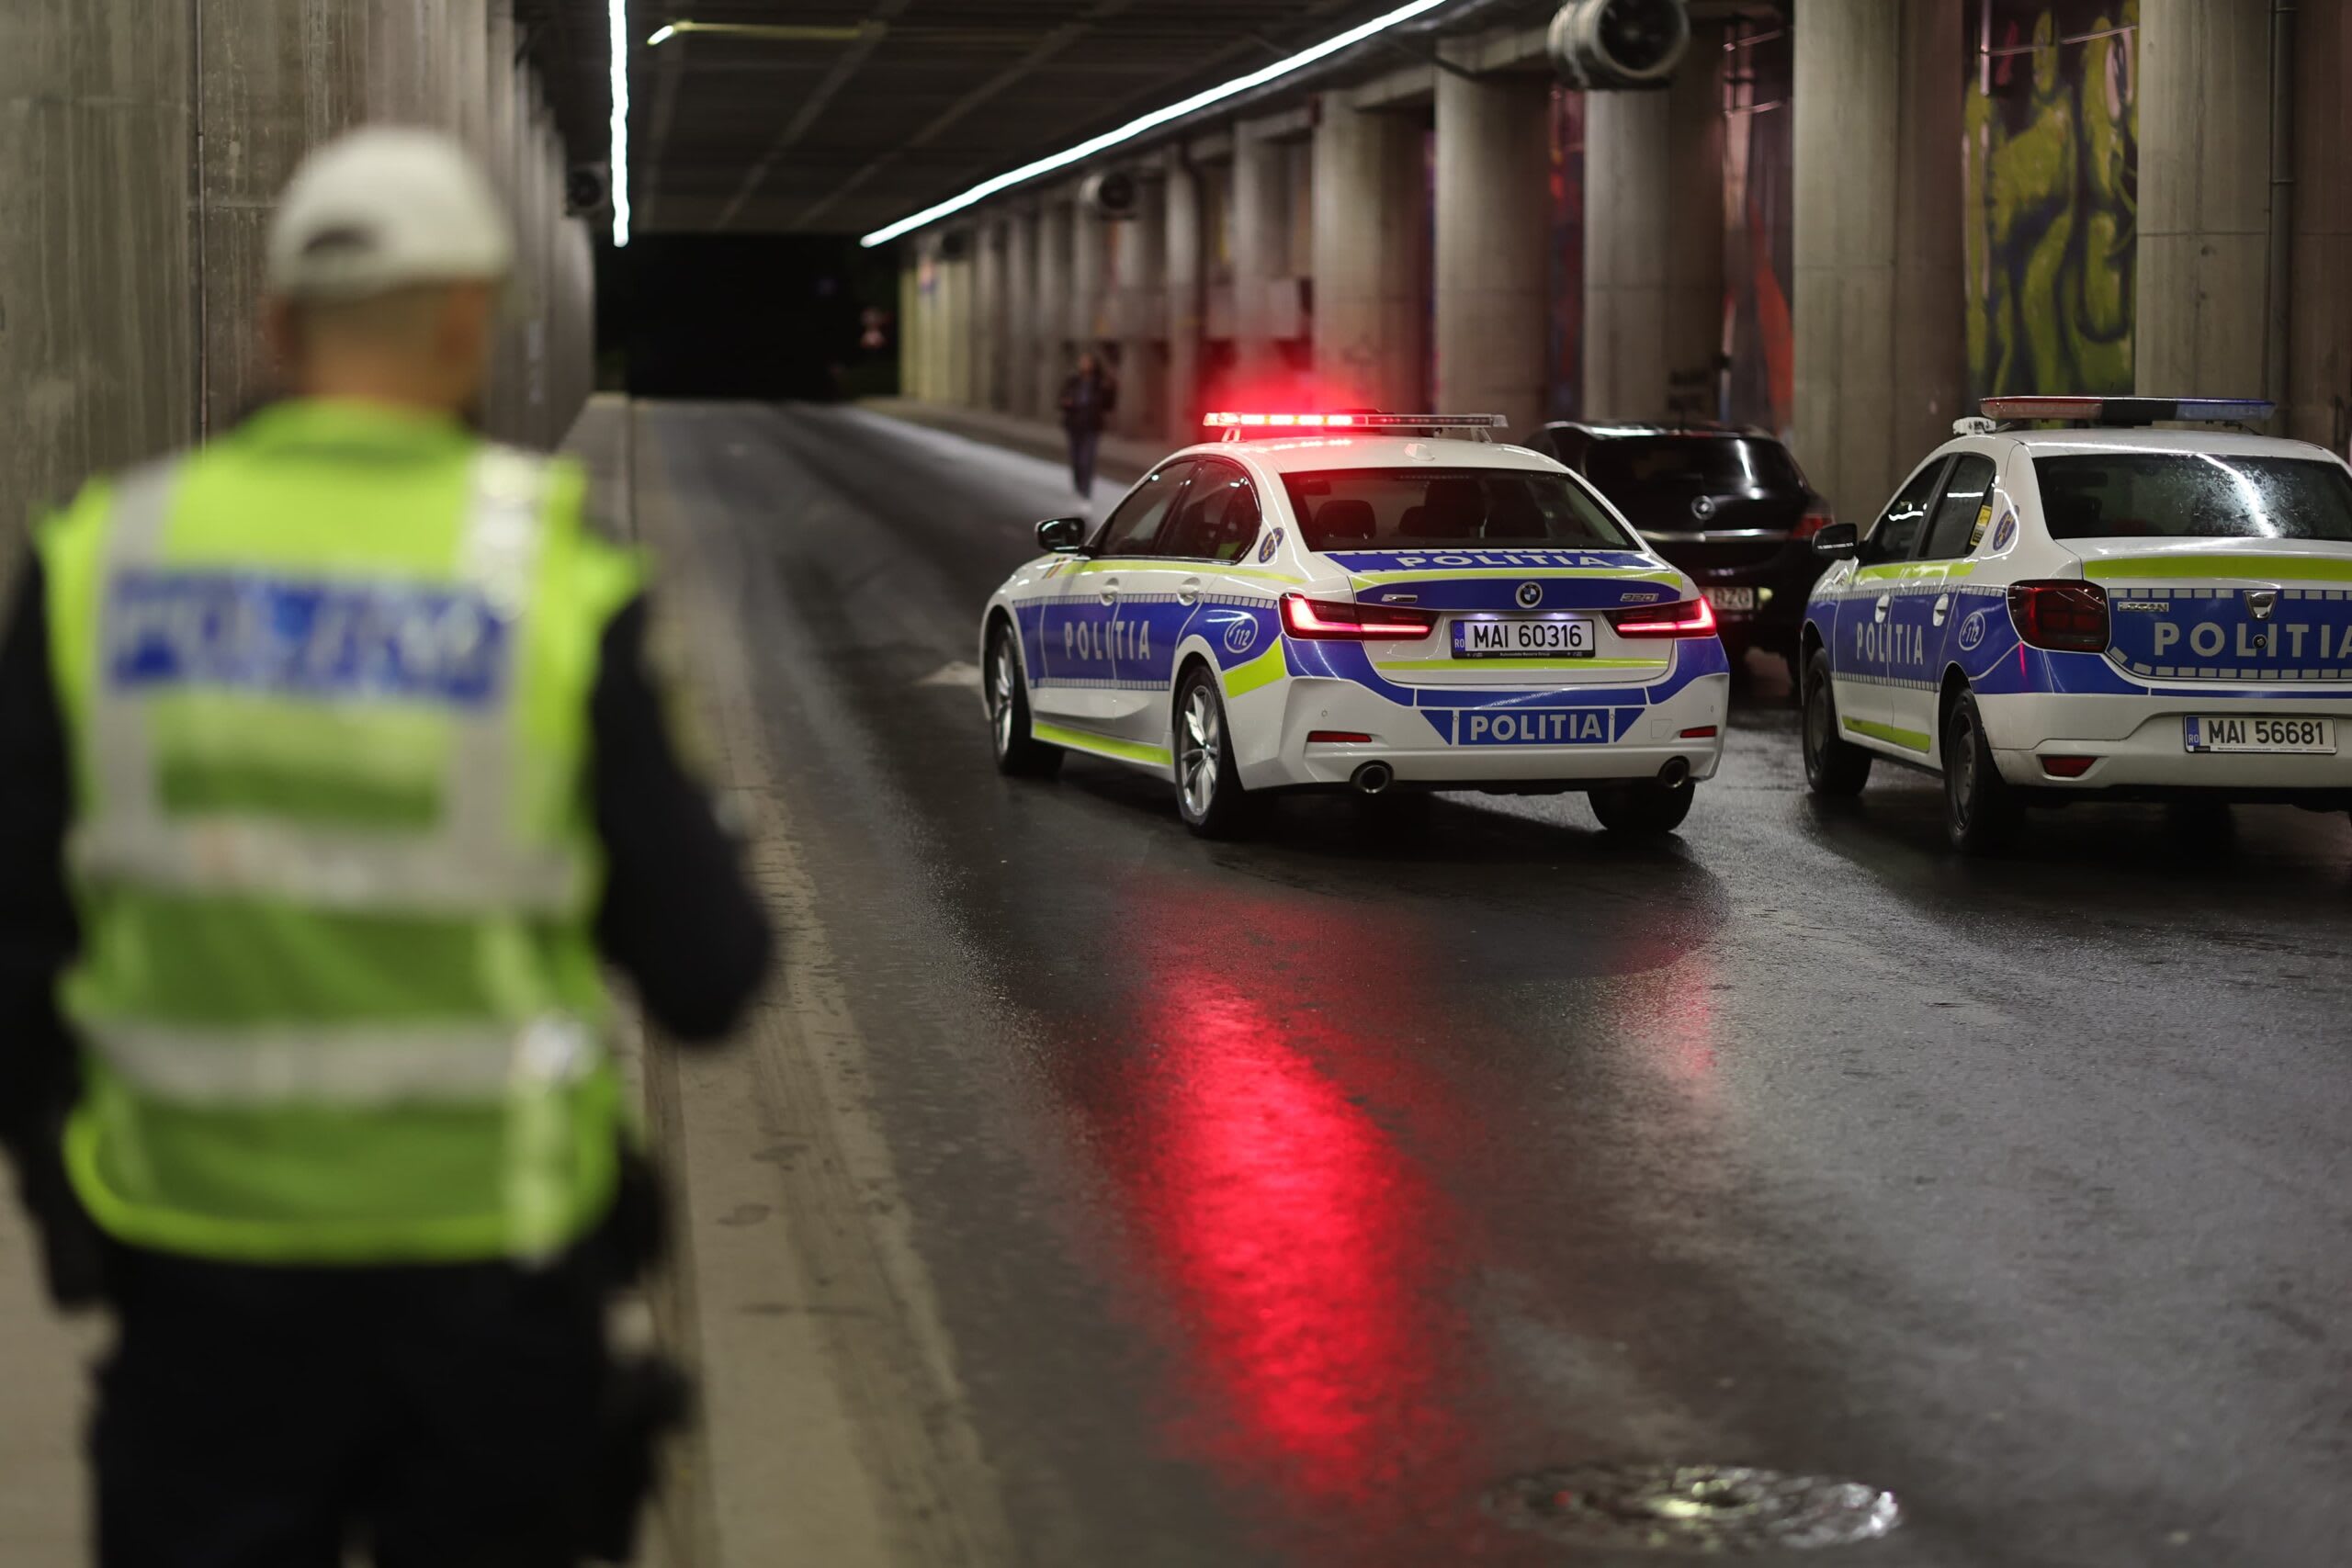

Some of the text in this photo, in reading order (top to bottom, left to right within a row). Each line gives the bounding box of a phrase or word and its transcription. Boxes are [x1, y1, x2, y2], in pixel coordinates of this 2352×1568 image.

[1396, 555, 1614, 567] POLITIA
[1065, 620, 1150, 660] POLITIA
[1233, 628, 1251, 648] 112
[1454, 638, 1464, 649] RO
[1474, 625, 1582, 649] MAI 60316
[1856, 622, 1924, 666] POLITIA
[1966, 626, 1980, 642] 112
[1470, 713, 1604, 741] POLITIA
[2209, 720, 2324, 745] MAI 56681
[2188, 734, 2199, 744] RO
